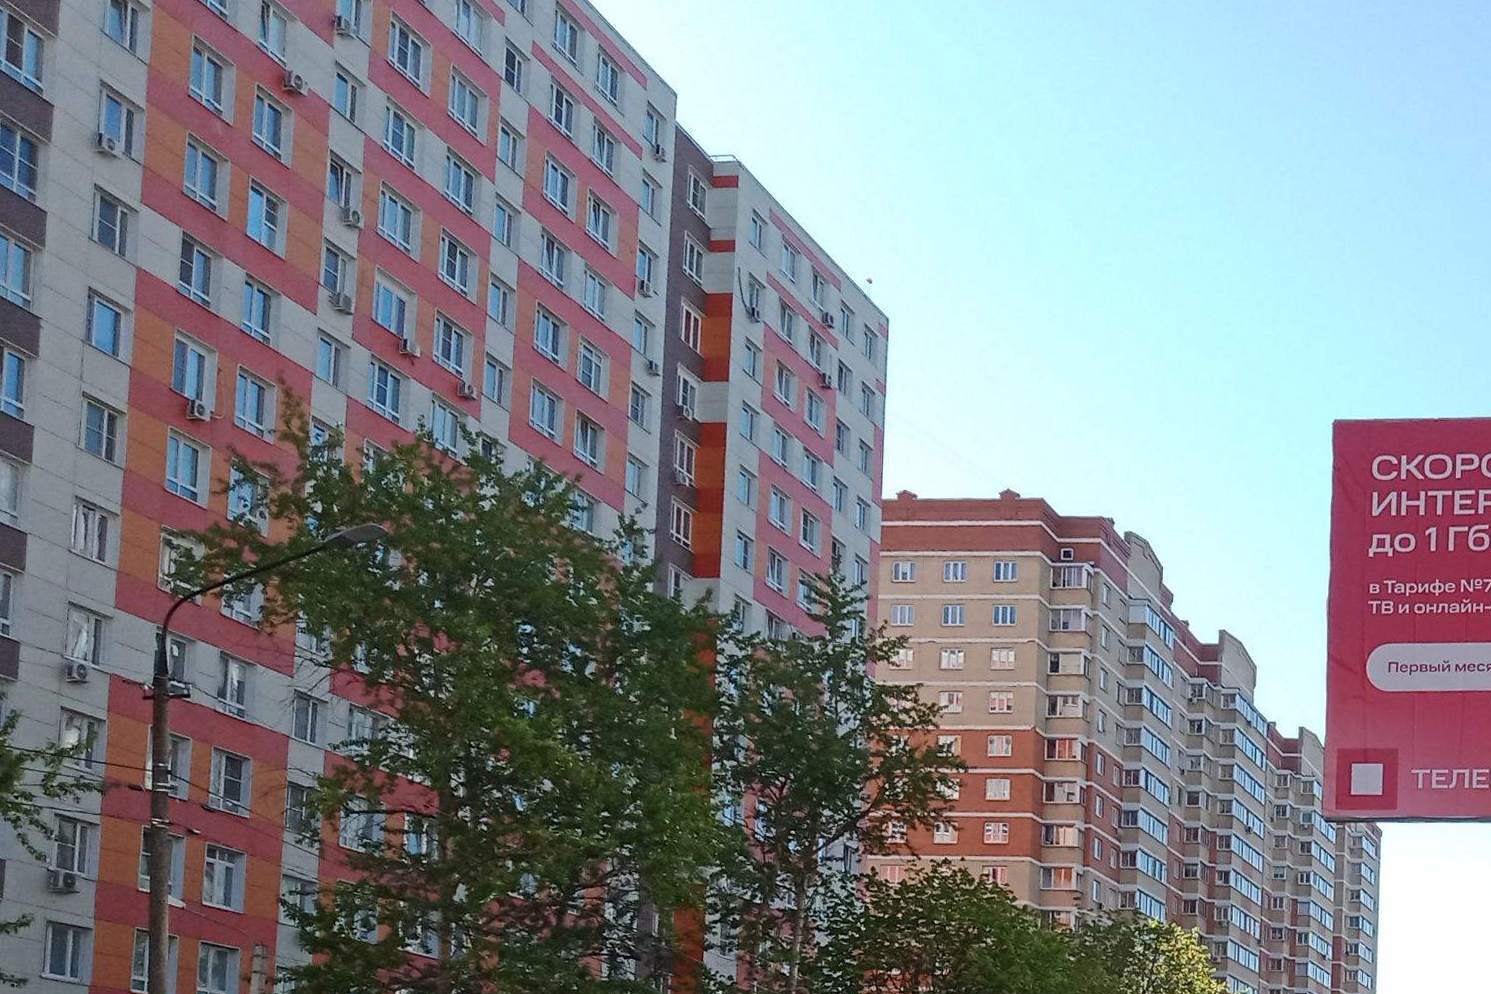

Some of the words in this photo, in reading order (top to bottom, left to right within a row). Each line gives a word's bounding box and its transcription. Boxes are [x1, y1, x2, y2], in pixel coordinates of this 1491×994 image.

[1368, 530, 1415, 557] до
[1425, 528, 1437, 552] 1
[1369, 582, 1380, 594] в
[1384, 579, 1456, 598] Тарифе
[1368, 601, 1394, 615] ТВ
[1398, 602, 1409, 614] и
[1388, 660, 1451, 677] Первый
